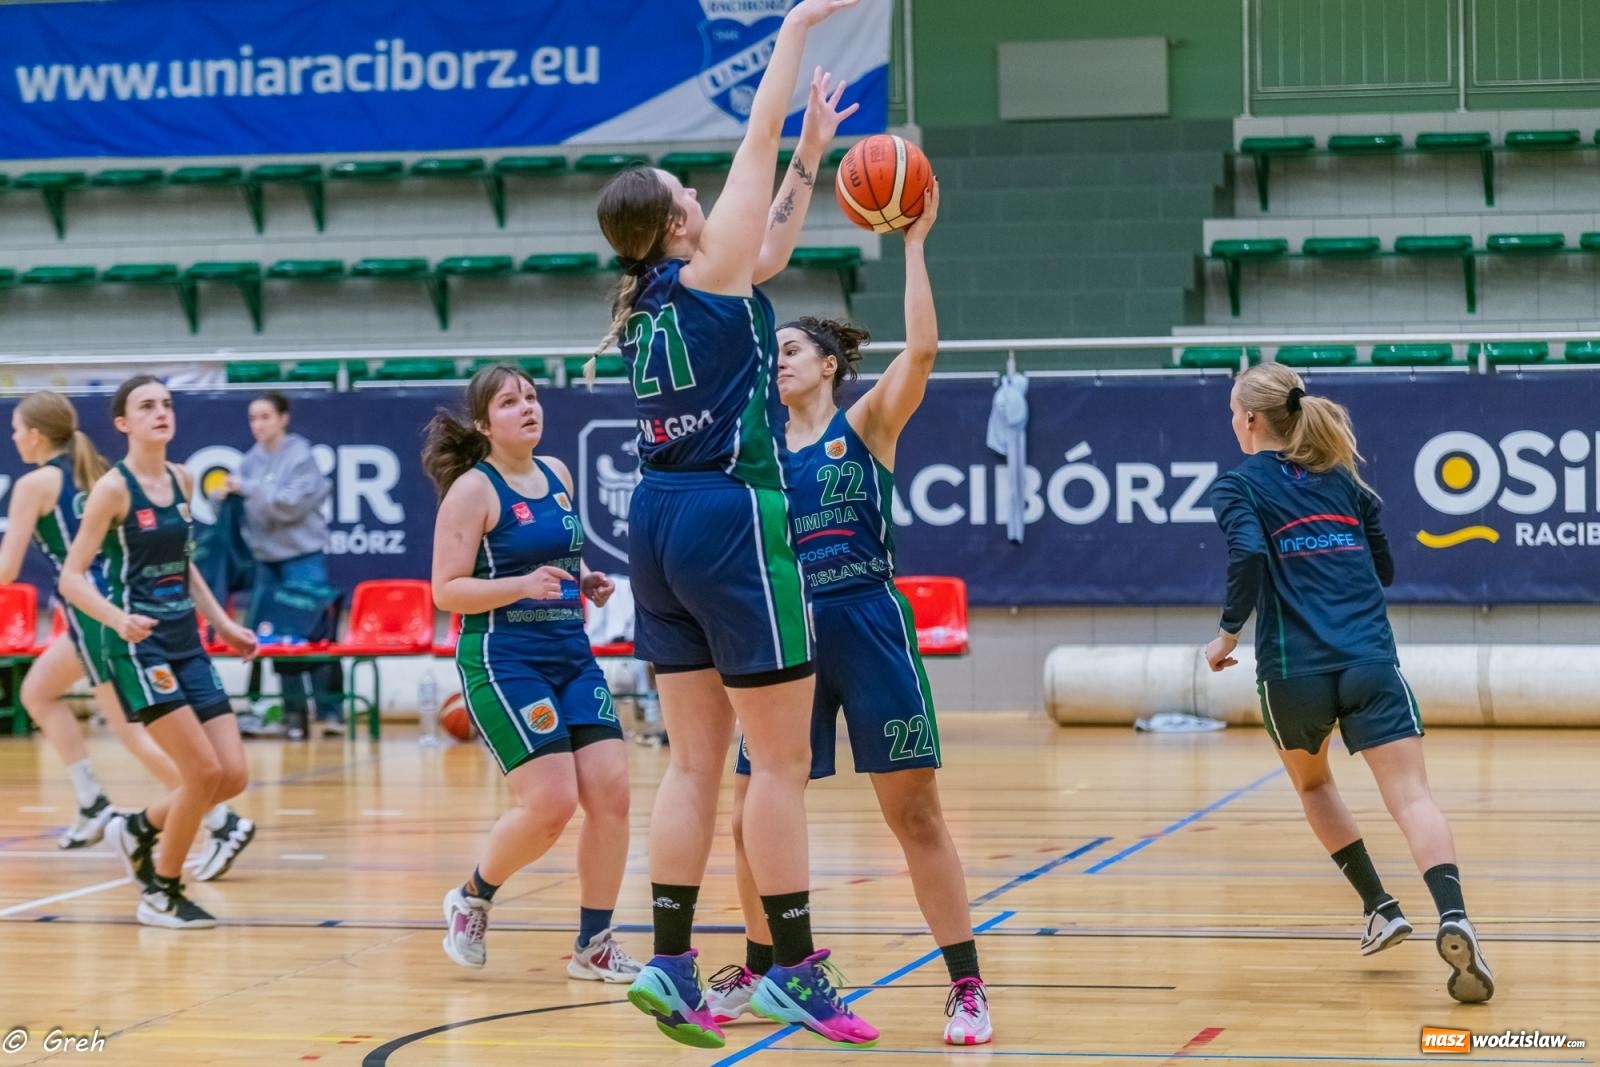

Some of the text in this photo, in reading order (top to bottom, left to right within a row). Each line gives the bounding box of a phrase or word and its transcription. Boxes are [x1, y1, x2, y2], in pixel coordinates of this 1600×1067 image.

[16, 39, 599, 102] www.uniaraciborz.eu
[624, 302, 697, 399] 21
[816, 460, 868, 507] 22
[1414, 429, 1600, 516] OSi
[1280, 533, 1357, 553] INFOSAFE
[884, 714, 934, 761] 22
